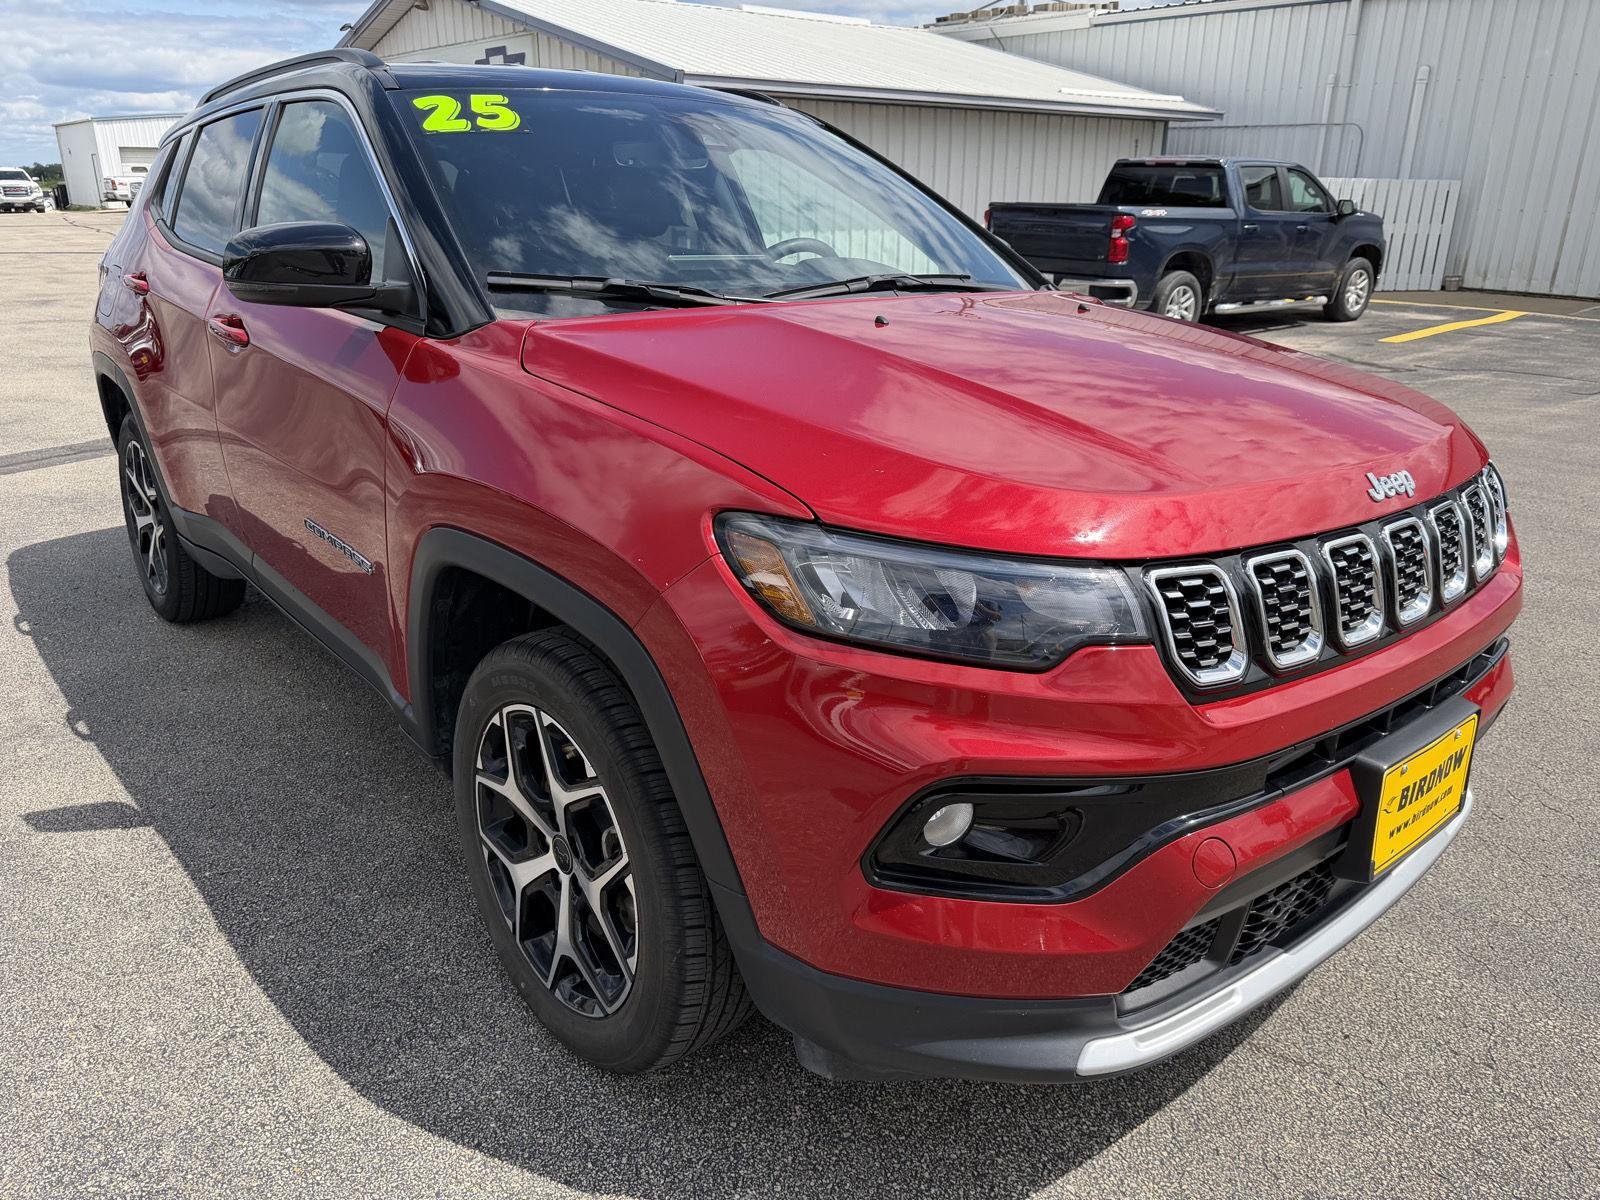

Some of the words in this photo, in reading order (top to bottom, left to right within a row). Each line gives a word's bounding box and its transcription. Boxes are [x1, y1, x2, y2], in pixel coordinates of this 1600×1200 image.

[412, 94, 521, 132] 25
[1365, 470, 1416, 503] Jeep
[1397, 744, 1468, 812] BIRDNOW
[1388, 786, 1454, 839] www.birdnow.com
